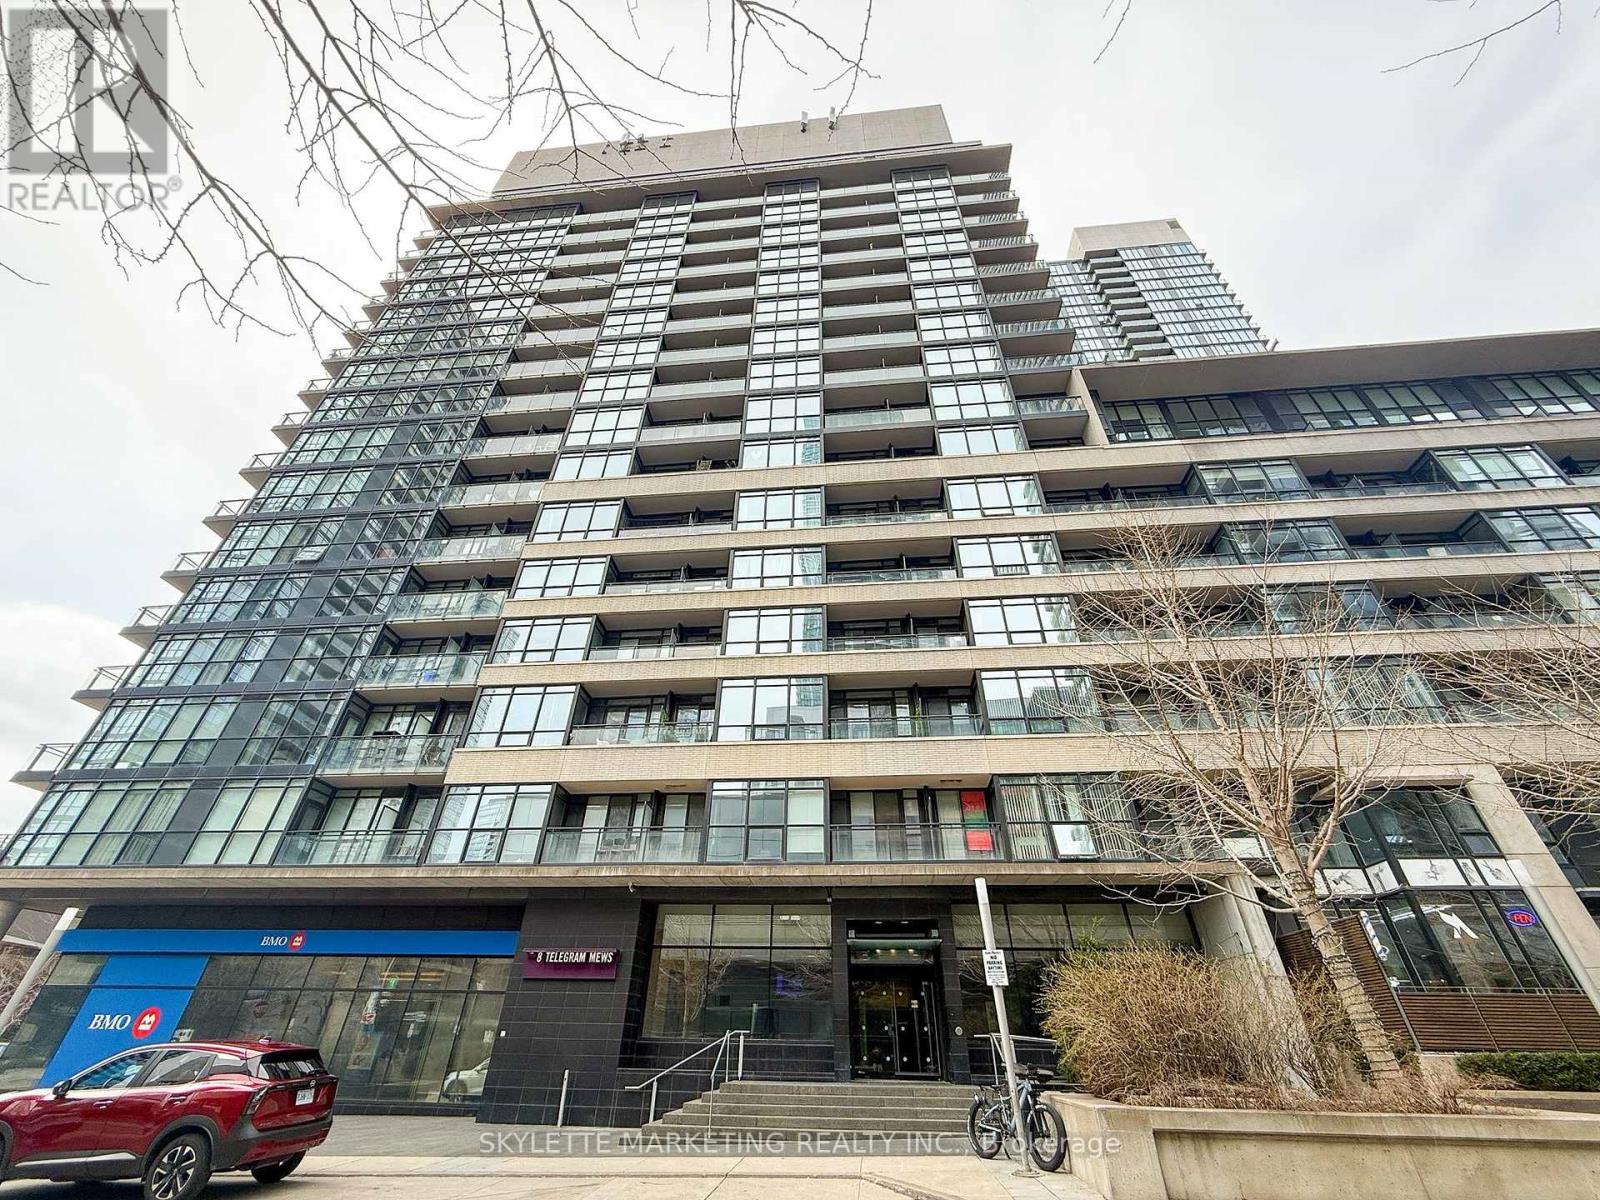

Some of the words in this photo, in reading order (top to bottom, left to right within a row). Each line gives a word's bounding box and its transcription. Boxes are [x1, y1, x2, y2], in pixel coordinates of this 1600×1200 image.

[1510, 913, 1533, 923] PEN
[260, 936, 288, 946] BMO
[536, 951, 543, 963] 8
[545, 951, 587, 963] TELEGRAM
[588, 951, 614, 963] MEWS
[88, 1014, 131, 1030] BMO
